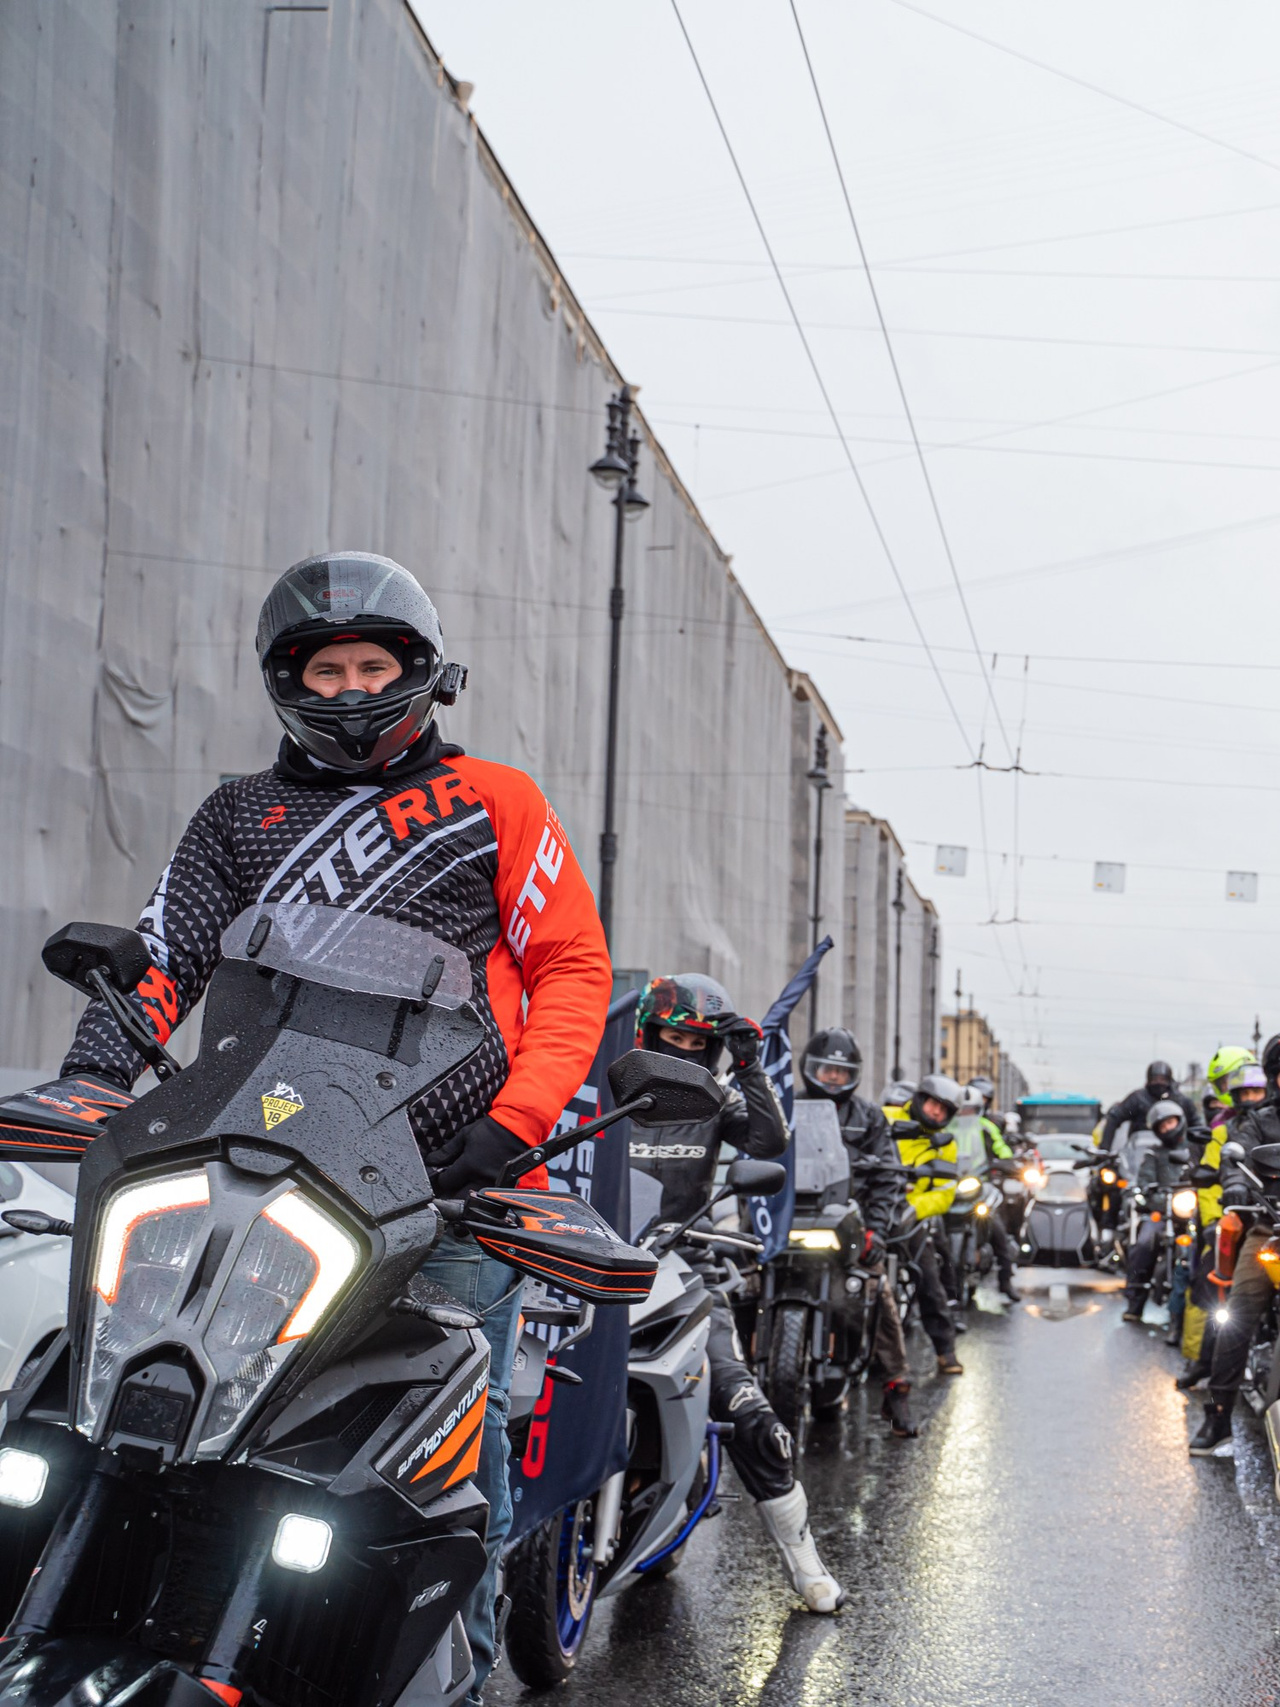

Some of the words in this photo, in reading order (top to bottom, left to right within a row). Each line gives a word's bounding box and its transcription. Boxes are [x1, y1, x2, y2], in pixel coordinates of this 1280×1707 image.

[272, 771, 480, 950] ETERR
[263, 1097, 302, 1113] PROJECT
[267, 1111, 282, 1123] 18
[397, 1437, 428, 1479] SUPER
[424, 1367, 488, 1459] ADVENTURE
[409, 1580, 451, 1612] KTM
